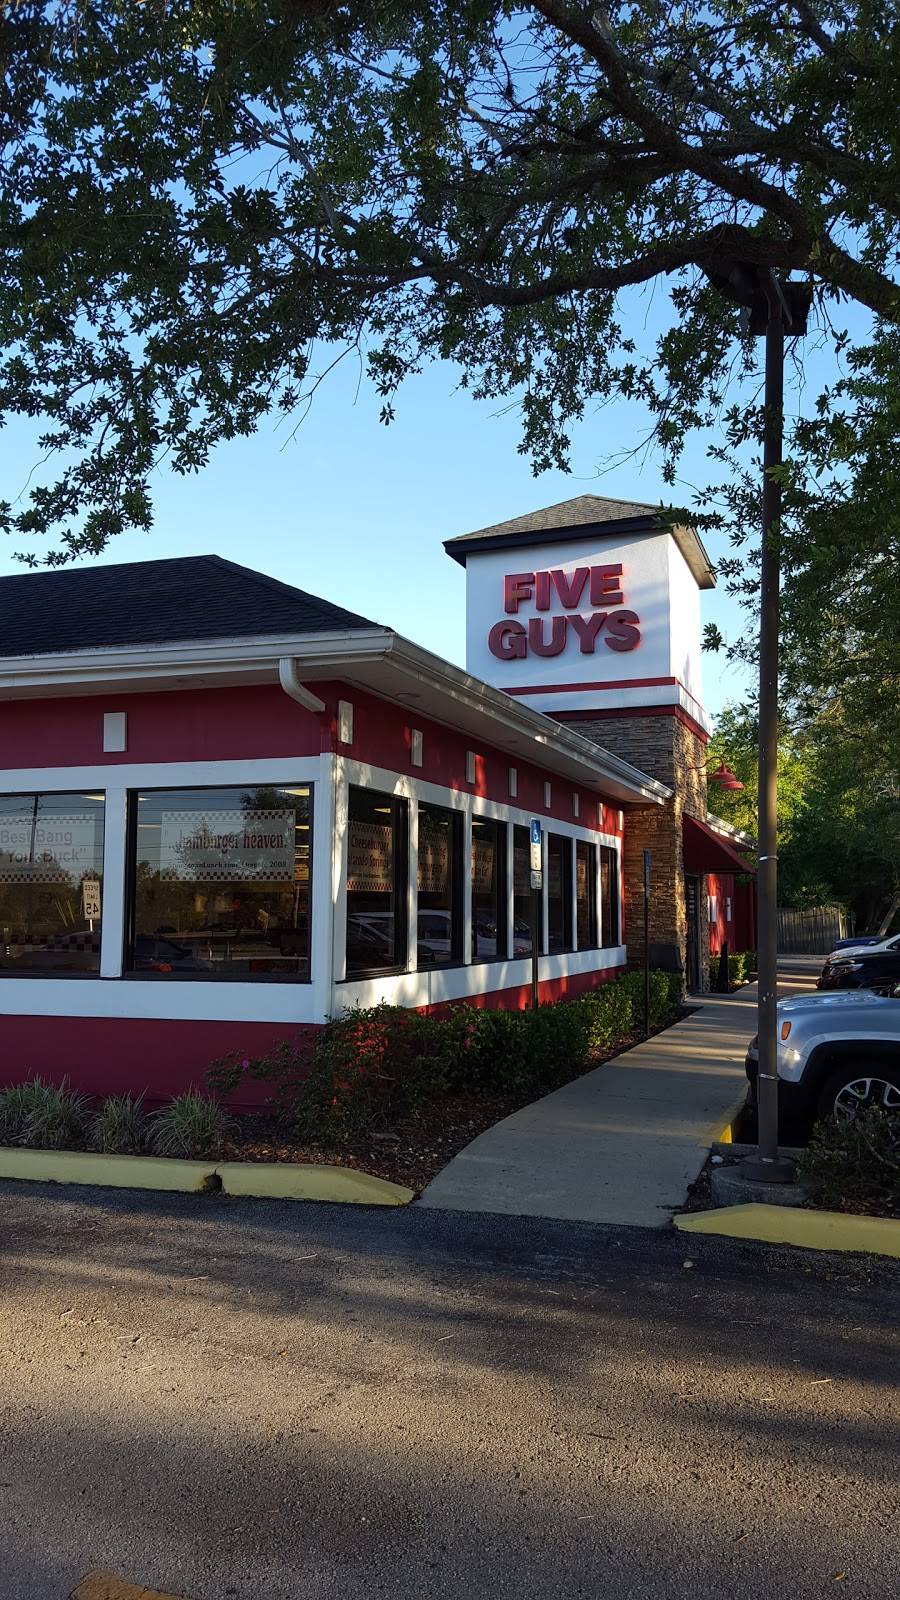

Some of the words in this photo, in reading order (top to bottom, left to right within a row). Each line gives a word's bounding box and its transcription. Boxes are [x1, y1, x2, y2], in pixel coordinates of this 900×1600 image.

[504, 563, 624, 614] FIVE
[488, 609, 641, 661] GUYS
[36, 829, 72, 846] Bang
